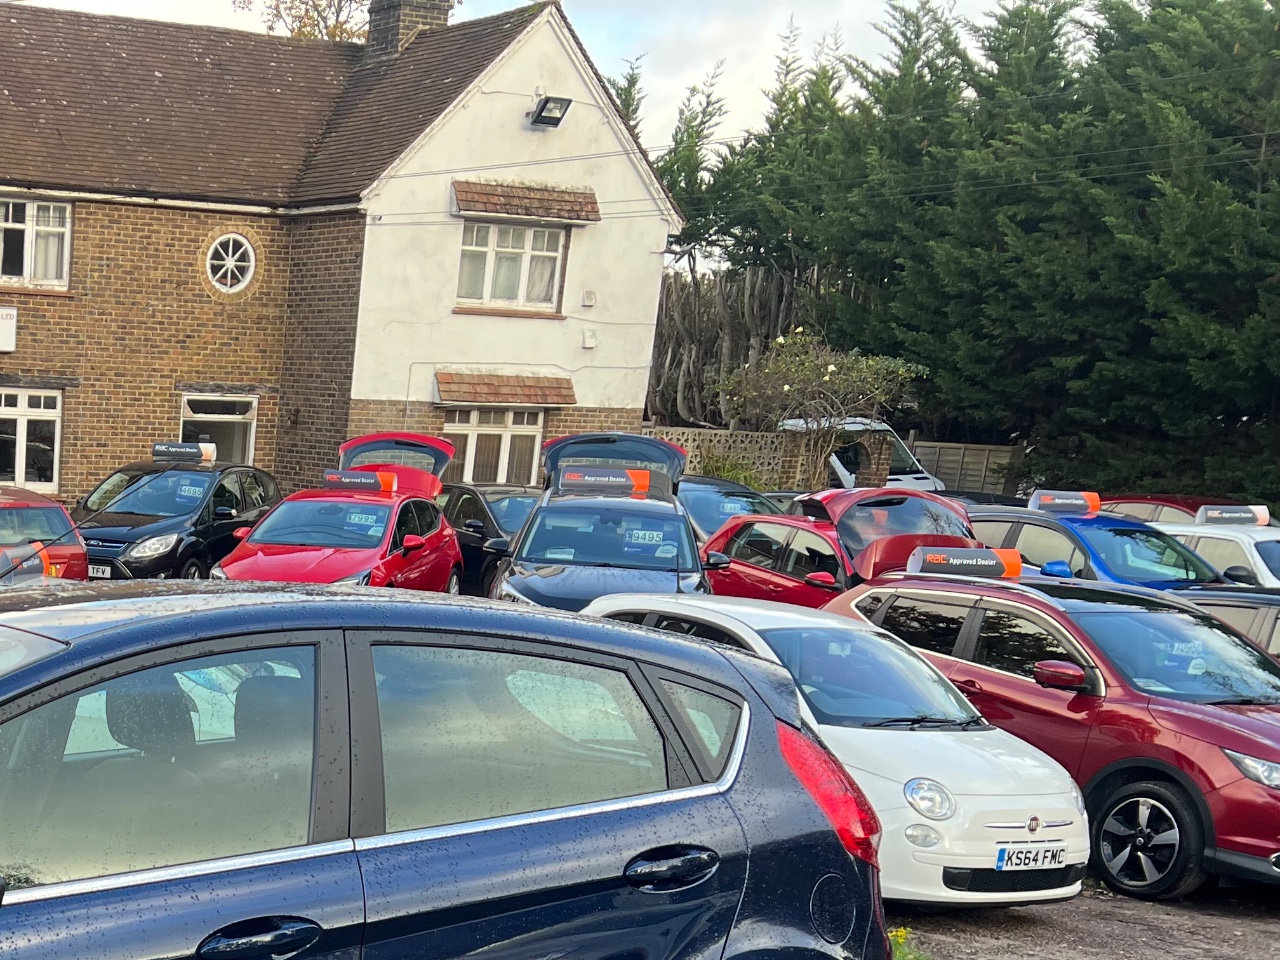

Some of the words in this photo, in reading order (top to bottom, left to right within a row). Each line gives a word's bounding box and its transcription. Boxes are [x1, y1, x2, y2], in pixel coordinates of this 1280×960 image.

[1, 313, 15, 321] LTD
[625, 531, 662, 542] £9495
[949, 557, 977, 566] Approved
[977, 558, 996, 566] Dealer
[91, 567, 106, 575] TFV
[1005, 850, 1039, 867] KS64
[1041, 848, 1065, 866] FMC
